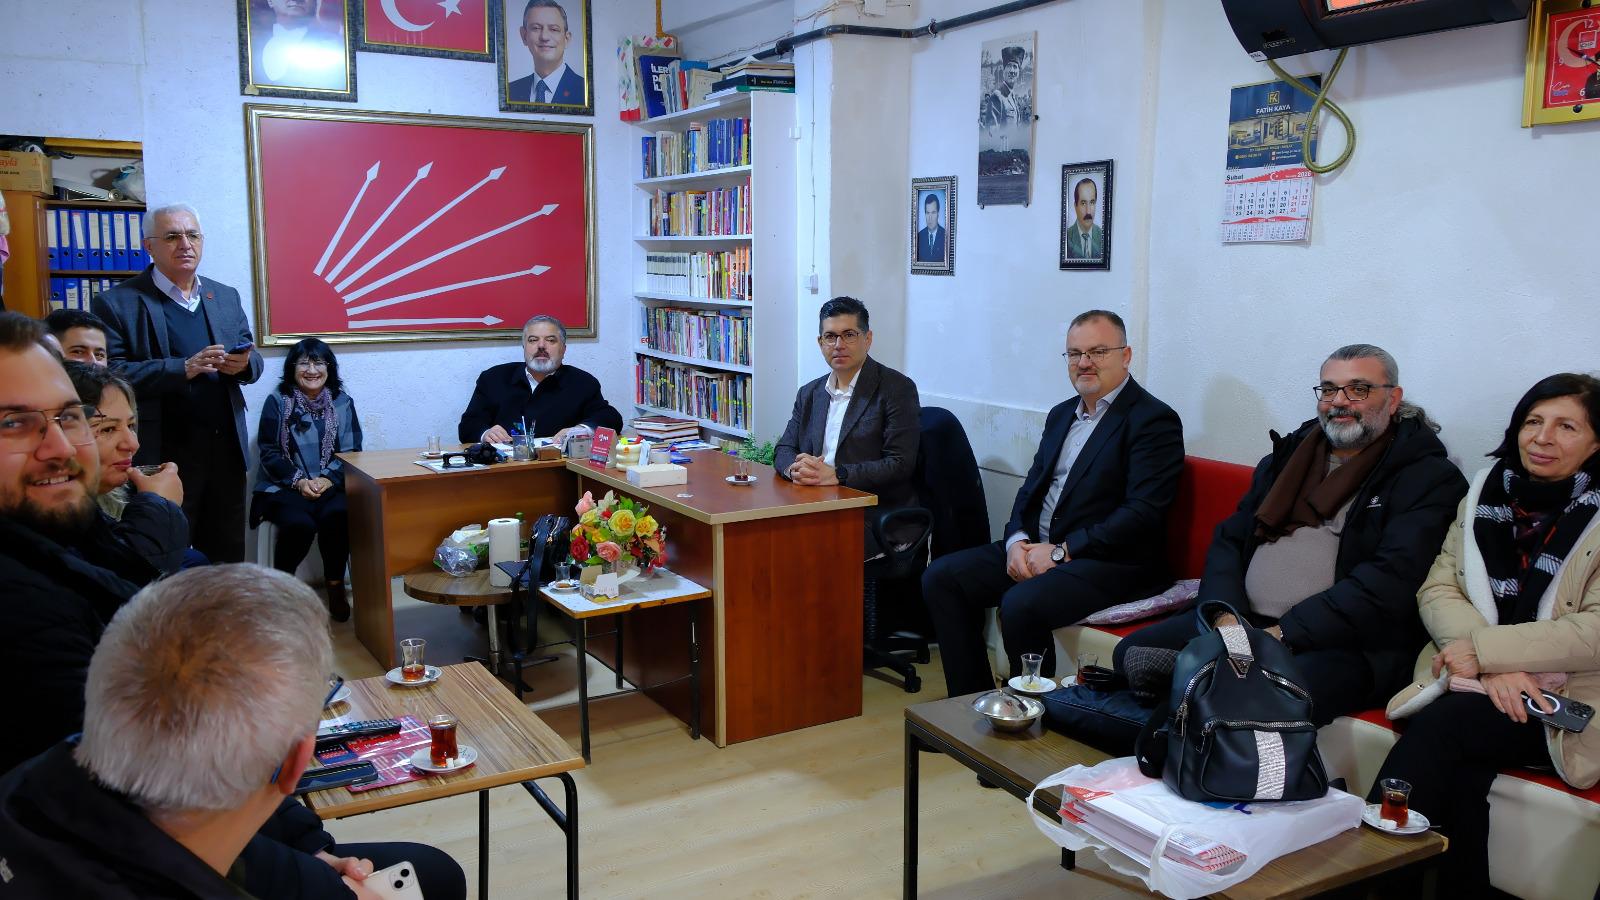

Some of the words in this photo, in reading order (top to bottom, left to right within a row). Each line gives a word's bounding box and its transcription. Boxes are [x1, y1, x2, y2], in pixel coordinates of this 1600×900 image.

[1584, 20, 1594, 28] 12
[1580, 88, 1586, 96] 6
[1256, 106, 1273, 114] FATİH
